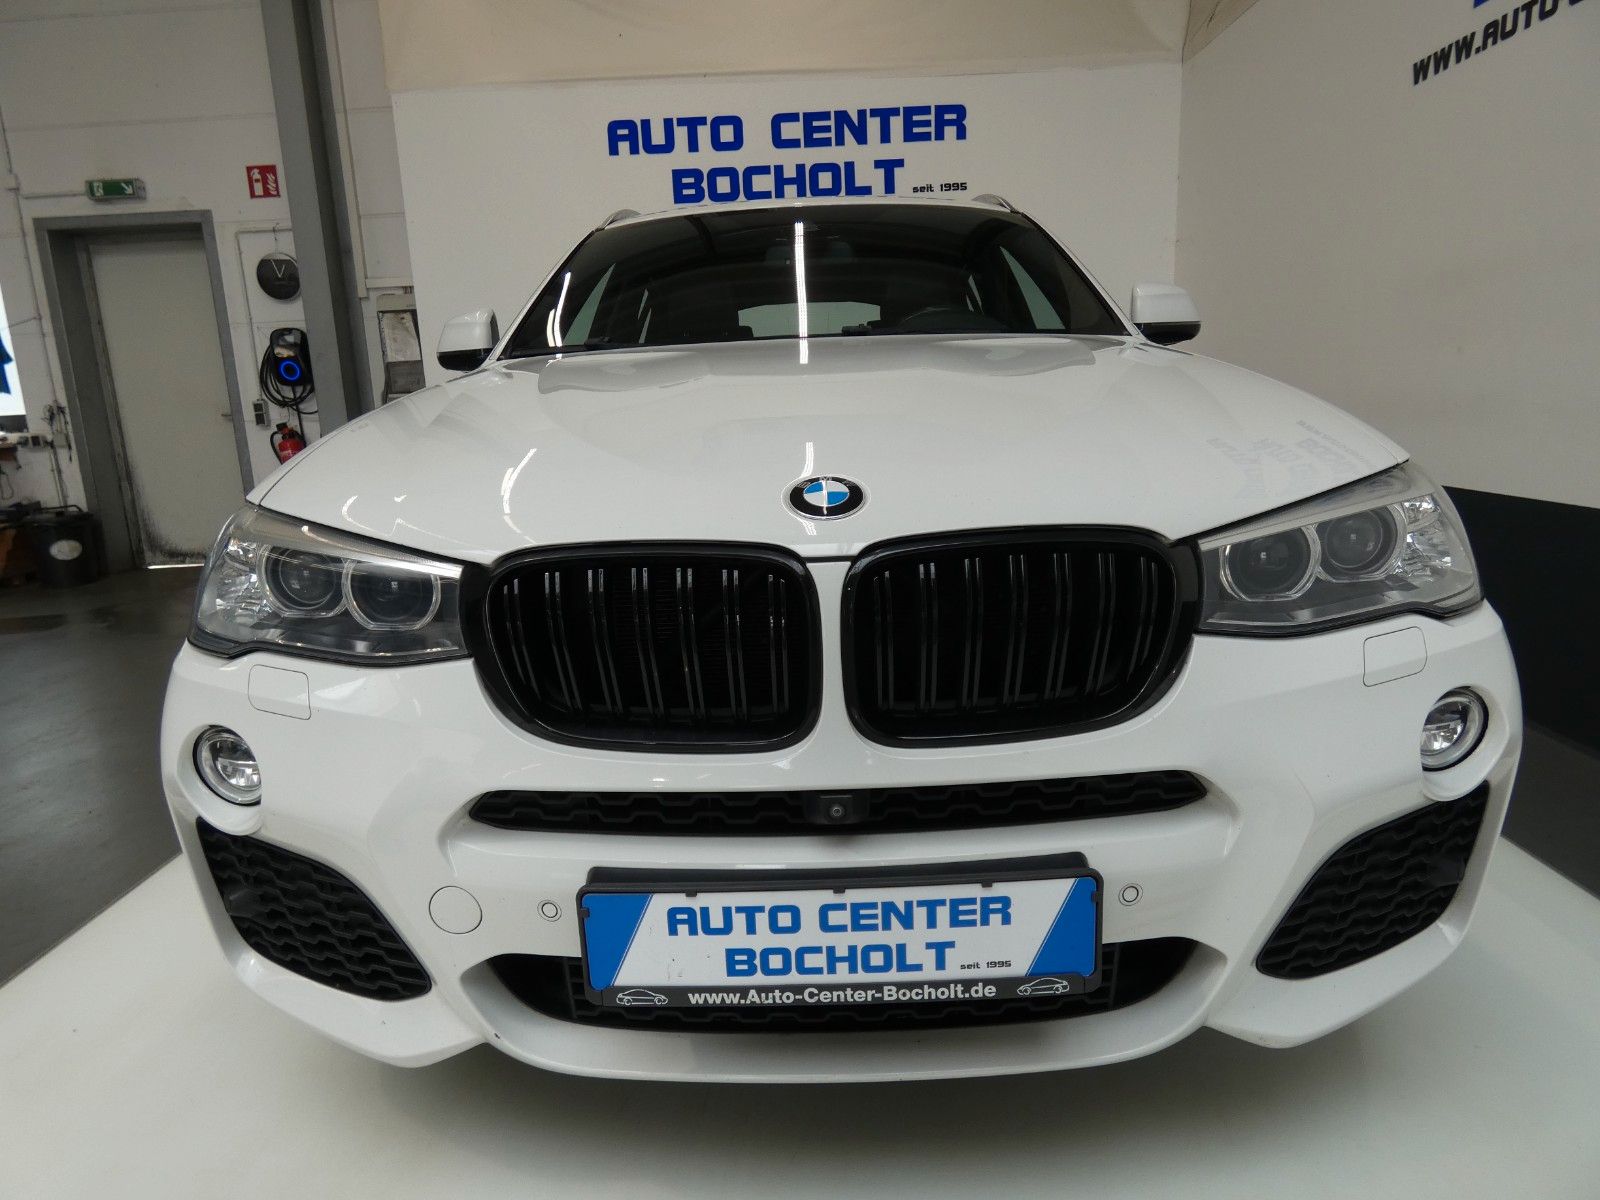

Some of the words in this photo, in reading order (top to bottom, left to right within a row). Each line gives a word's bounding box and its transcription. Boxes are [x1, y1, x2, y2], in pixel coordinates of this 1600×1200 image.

[1413, 0, 1585, 85] WWW.AUTO
[607, 115, 744, 156] AUTO
[771, 104, 967, 149] CENTER
[672, 158, 905, 204] BOCHOLT
[912, 183, 935, 193] seit
[940, 182, 968, 192] 1995
[667, 905, 801, 936] AUTO
[818, 895, 1012, 933] CENTER
[725, 940, 956, 977] BOCHOLT
[960, 961, 980, 970] seit
[986, 960, 1012, 969] 1995
[688, 982, 997, 1005] www.Auto-Center-Bocholt.de
